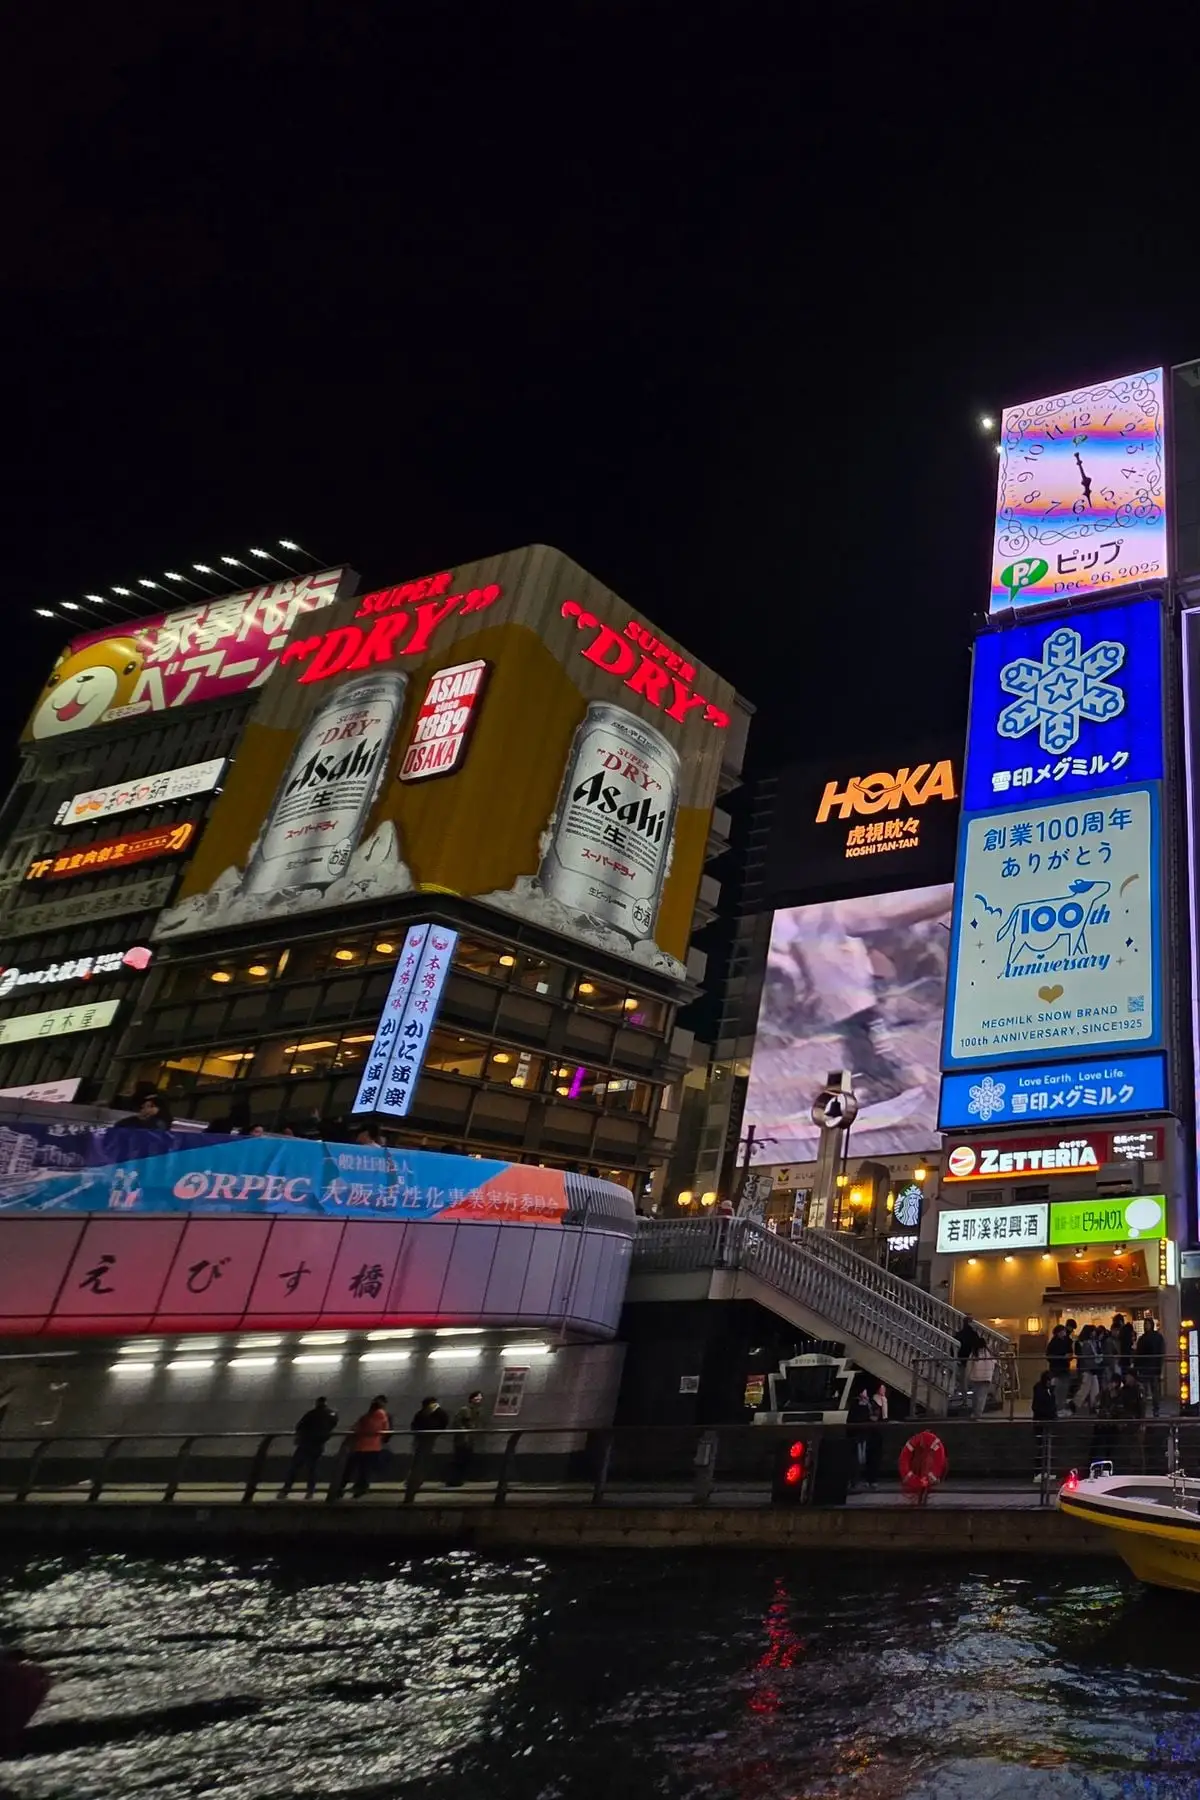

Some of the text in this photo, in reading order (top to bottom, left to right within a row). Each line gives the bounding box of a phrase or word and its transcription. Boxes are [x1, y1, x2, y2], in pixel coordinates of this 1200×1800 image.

[1045, 424, 1064, 440] 11
[1072, 412, 1091, 429] 12
[1024, 444, 1044, 463] 10
[1057, 538, 1124, 574] ピップ
[1054, 577, 1087, 593] Dec.
[1119, 560, 1160, 578] 2025
[355, 572, 453, 619] SUPER
[147, 569, 342, 662] 家事代行
[625, 620, 697, 682] SUPER
[425, 666, 478, 704] ASAHI
[337, 710, 369, 724] SUPER
[434, 699, 459, 713] since
[415, 706, 468, 742] 1889
[285, 738, 382, 796] Asahi
[404, 736, 455, 774] OSAKA
[617, 748, 649, 771] SUPER
[992, 751, 1129, 792] 雪印メグミルク
[309, 791, 333, 810] 生
[573, 770, 665, 843] Asahi
[815, 760, 955, 823] HOKA
[603, 824, 627, 849] 生
[983, 807, 1133, 852] 創業100周年
[582, 848, 636, 880] スーパードライ
[846, 837, 918, 858] KOSHI TAN-TAN
[1001, 841, 1113, 878] ありがとう
[1020, 901, 1110, 935] 100th
[1002, 952, 1111, 978] Anniversary
[415, 955, 441, 1014] 本場の味
[982, 1005, 1118, 1029] MEGMILK SNOW BRAND
[960, 1037, 988, 1048] 100th
[1019, 1077, 1041, 1087] Love
[1079, 1071, 1101, 1081] Love
[1012, 1084, 1134, 1113] 雪印メグミルク
[979, 1147, 1098, 1173] ZETTERIA
[78, 1253, 384, 1298] えびす橋
